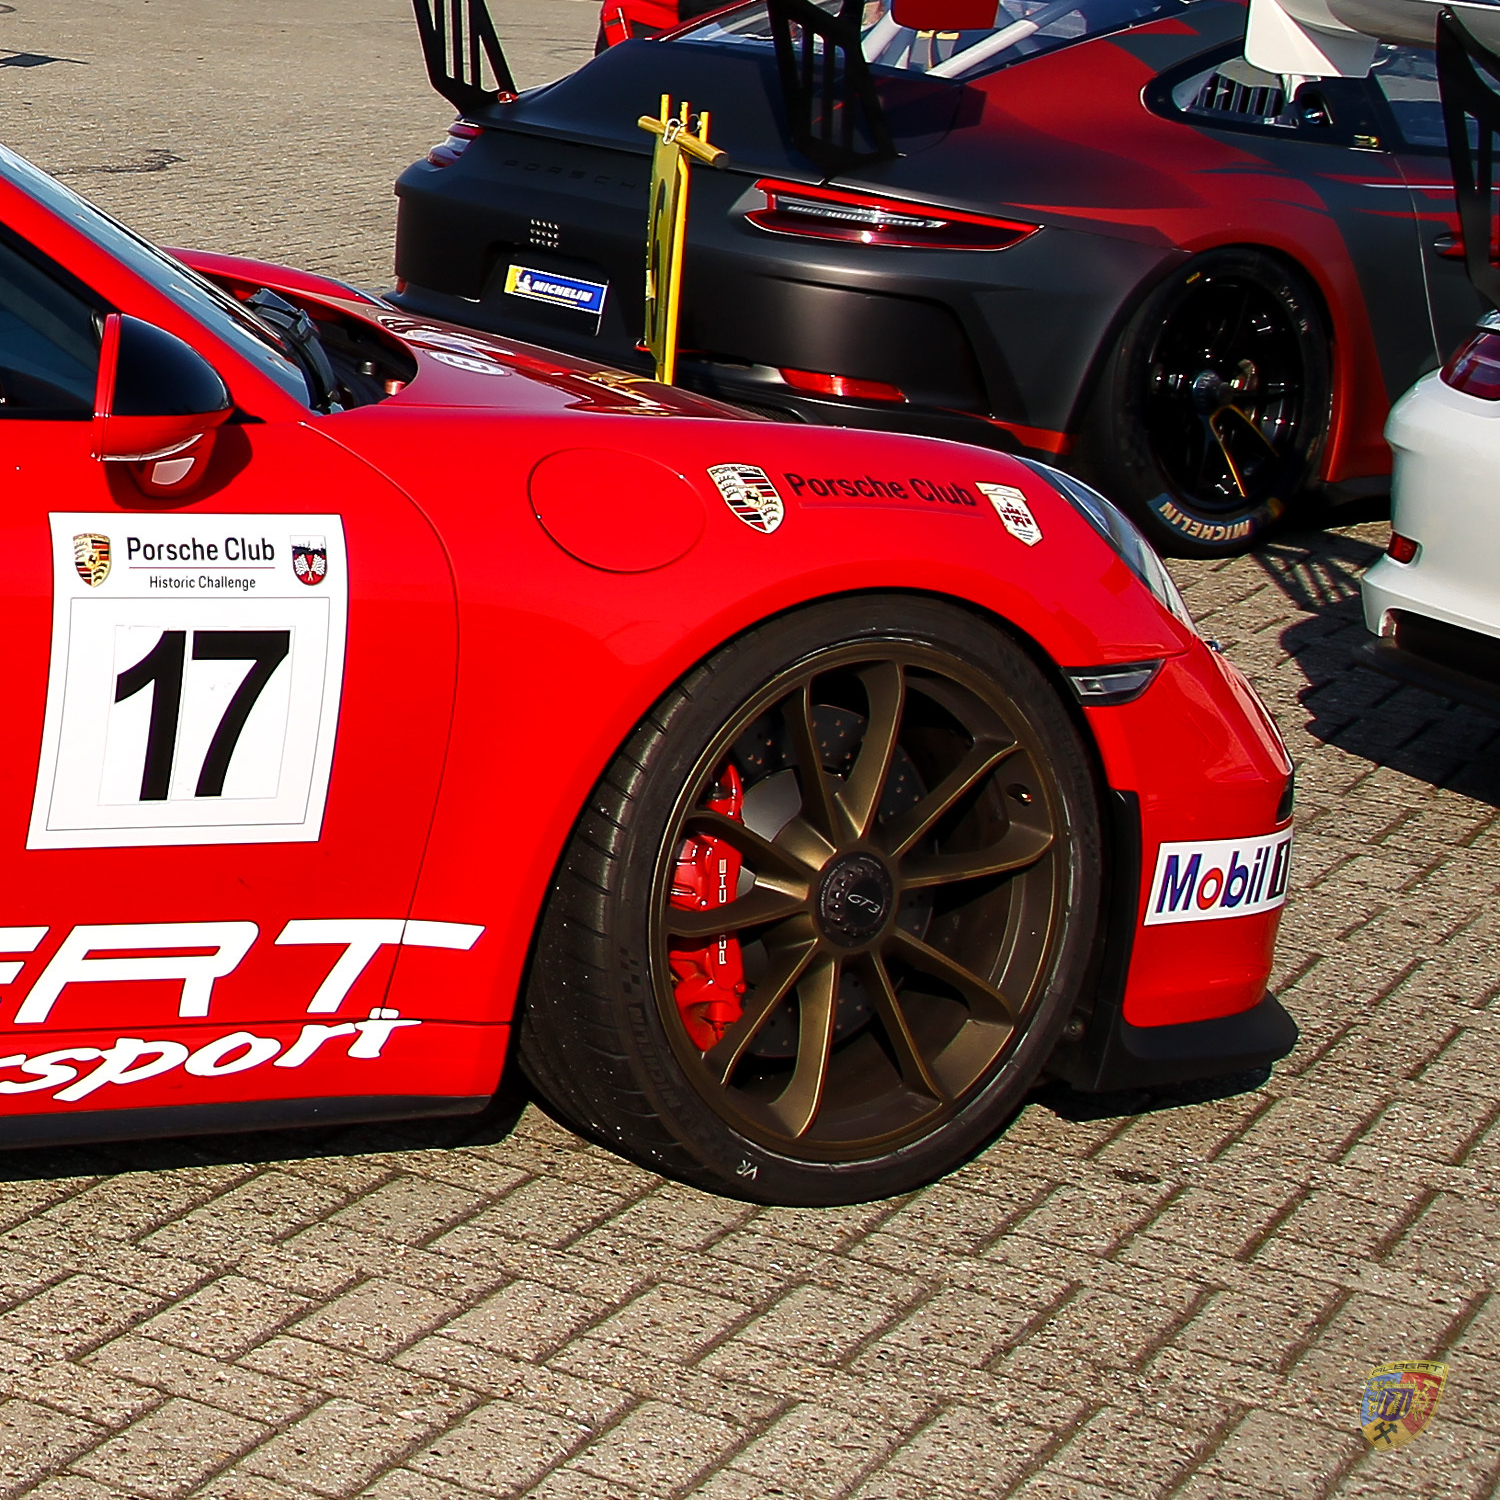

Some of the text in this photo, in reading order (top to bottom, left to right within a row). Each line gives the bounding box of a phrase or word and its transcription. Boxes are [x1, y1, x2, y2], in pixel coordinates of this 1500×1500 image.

[503, 159, 650, 194] PORSCH
[531, 280, 594, 303] MICHELIN
[783, 472, 977, 507] Porsche Club
[1158, 501, 1250, 541] MICHELIN
[126, 536, 276, 561] Porsche Club
[149, 575, 256, 592] Historic Challenge
[114, 629, 291, 802] 17
[1154, 845, 1272, 914] Mobil
[718, 858, 728, 966] POCHE
[847, 893, 881, 914] GT3
